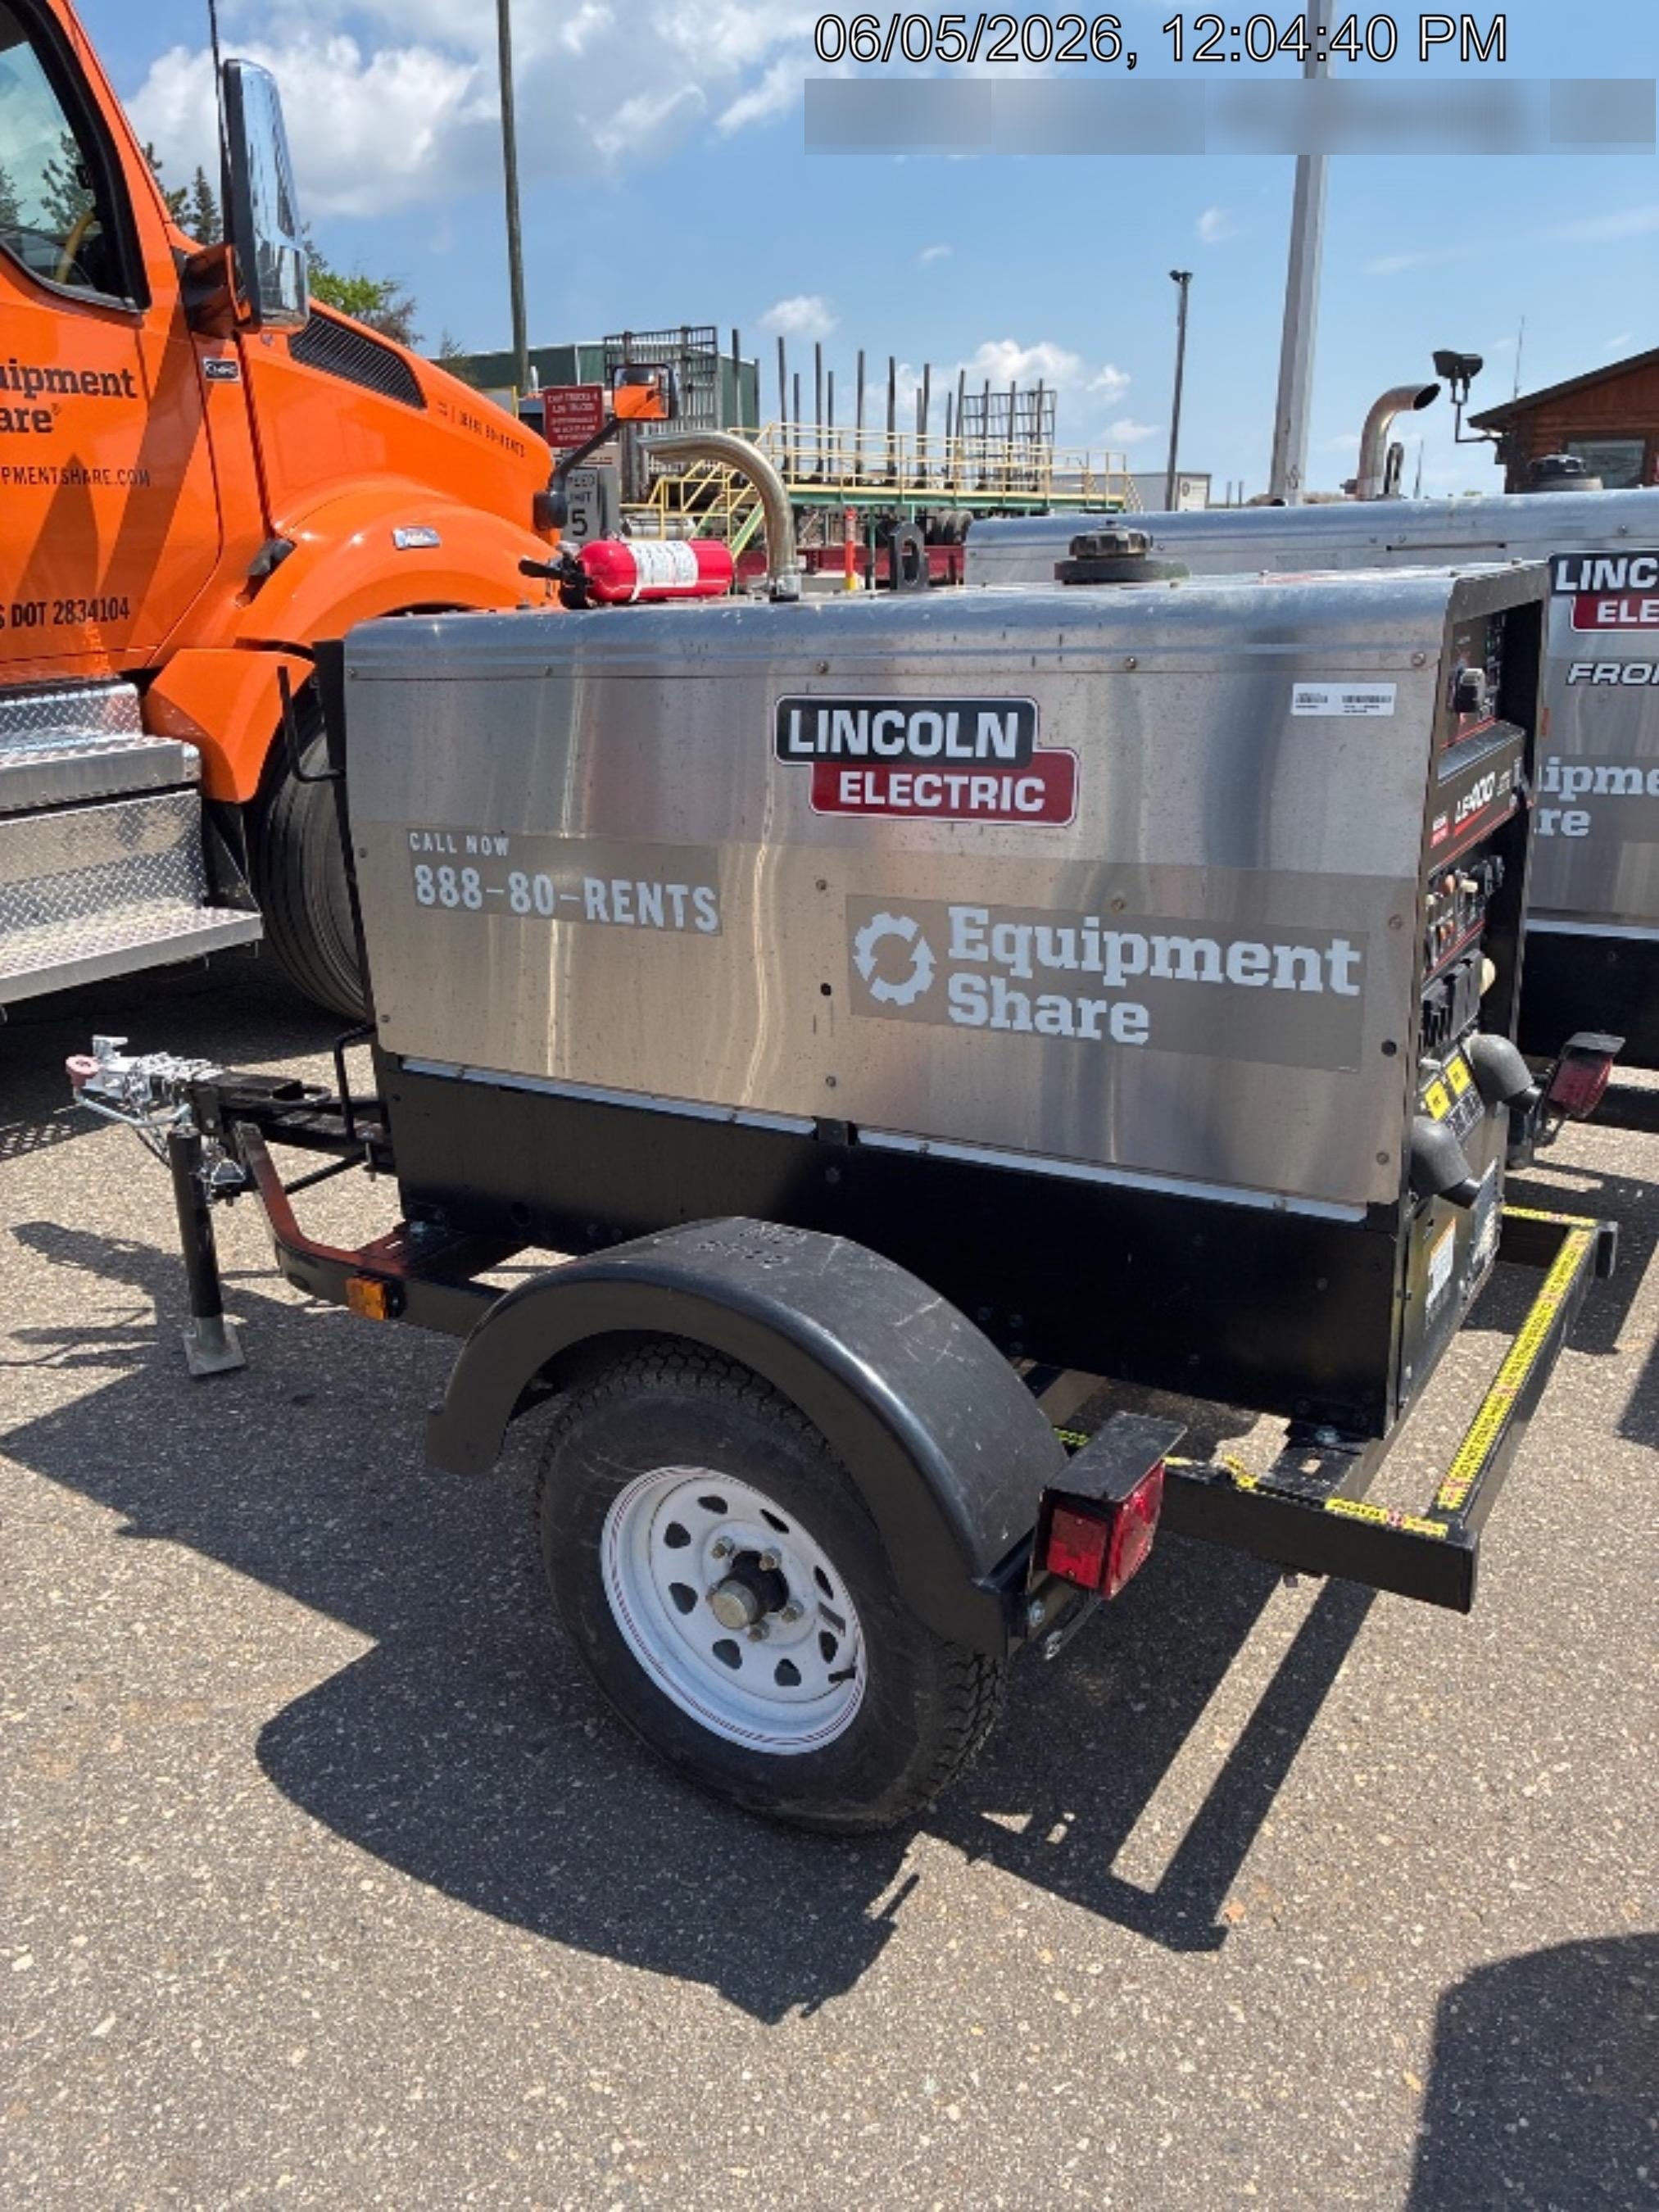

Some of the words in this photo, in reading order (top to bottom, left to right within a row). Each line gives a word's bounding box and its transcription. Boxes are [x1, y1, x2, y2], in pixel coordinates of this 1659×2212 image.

[572, 507, 588, 537] 5
[11, 601, 48, 628] DOT
[53, 596, 129, 625] 2834104
[1597, 599, 1659, 623] ELE
[787, 709, 1019, 759] LINCOLN
[839, 771, 1046, 813] ELECTRIC
[1533, 807, 1592, 836] re
[410, 832, 457, 854] CALL
[466, 834, 510, 856] NOW
[414, 863, 719, 933] 888-80-RENTS
[947, 905, 1362, 996] Equipment
[947, 972, 1149, 1046] Share
